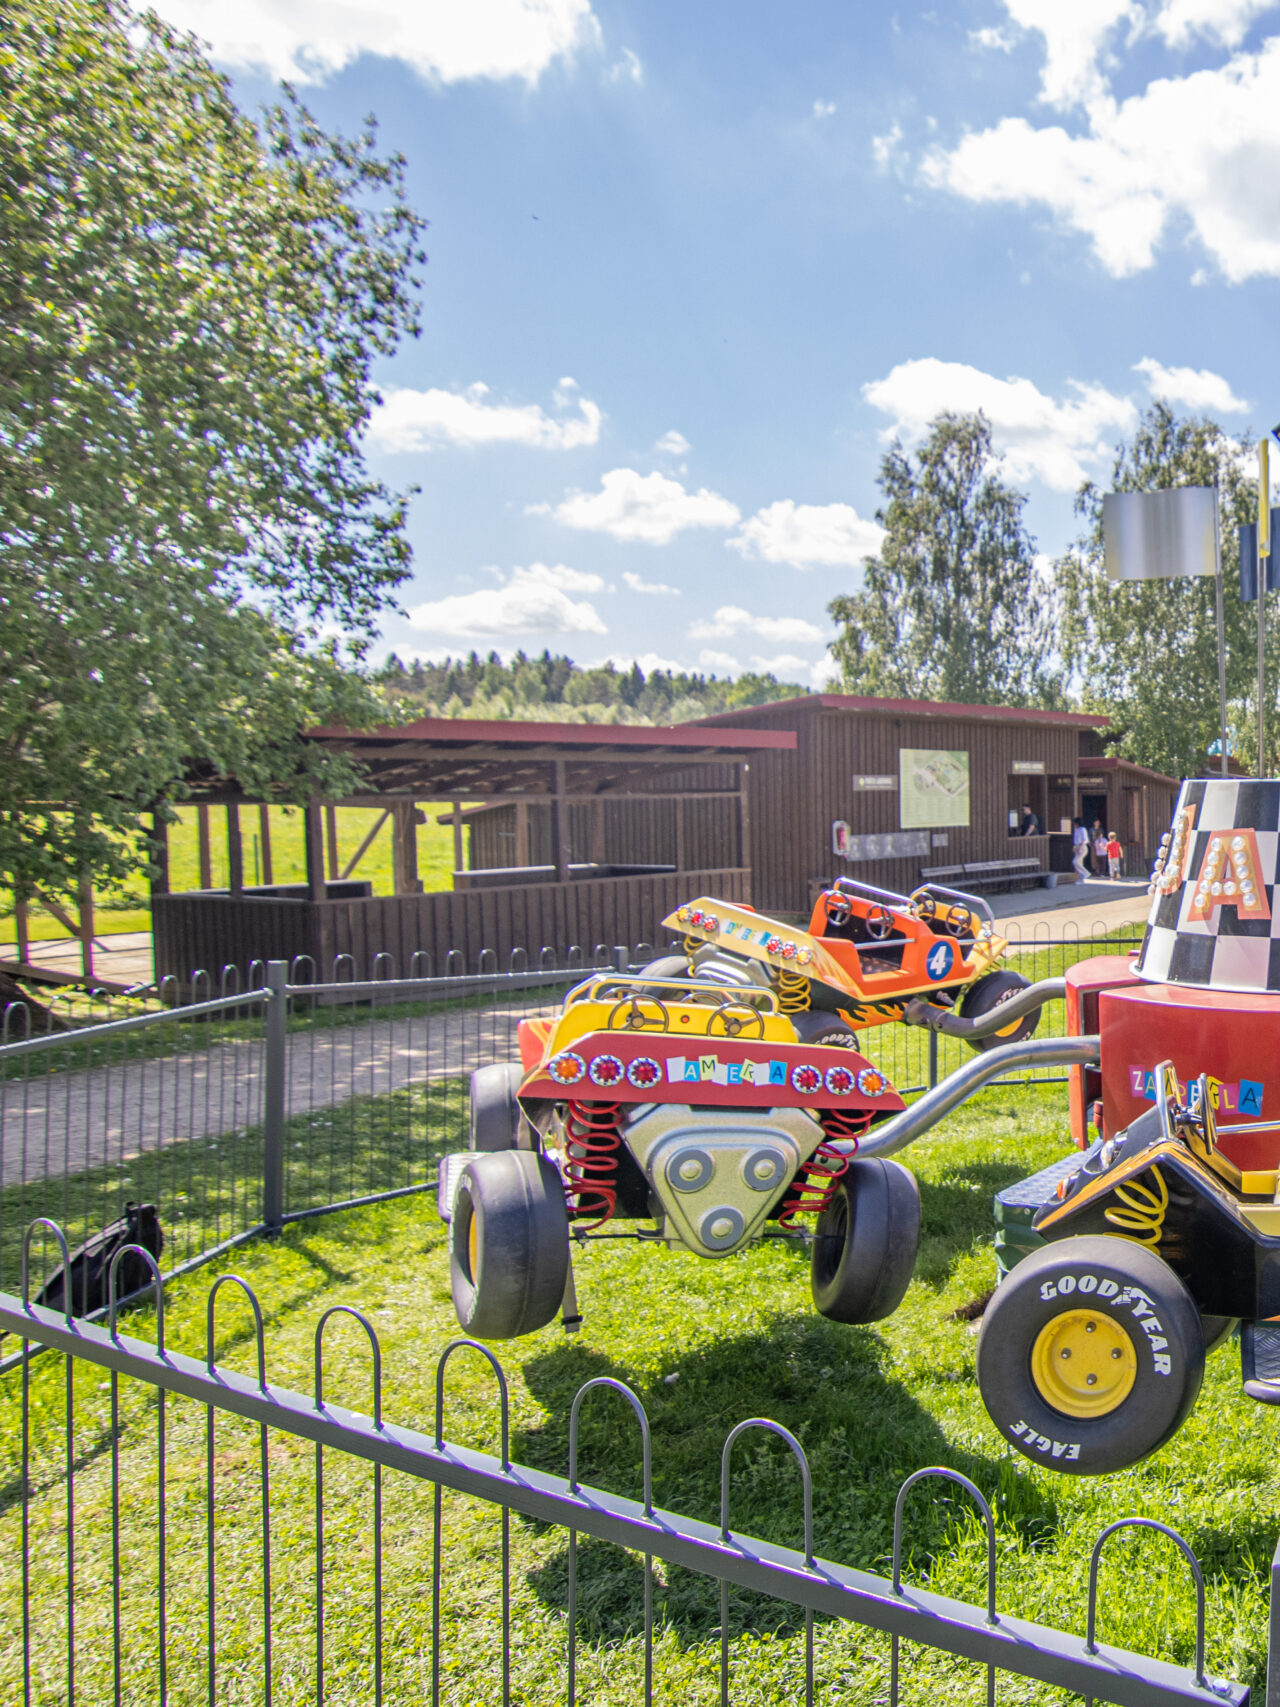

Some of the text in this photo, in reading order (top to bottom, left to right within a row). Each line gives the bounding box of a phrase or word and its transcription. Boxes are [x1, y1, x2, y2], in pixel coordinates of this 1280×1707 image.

[930, 945, 947, 975] 4
[1039, 1275, 1172, 1376] GOODYEAR
[1008, 1419, 1081, 1461] EAGLE
